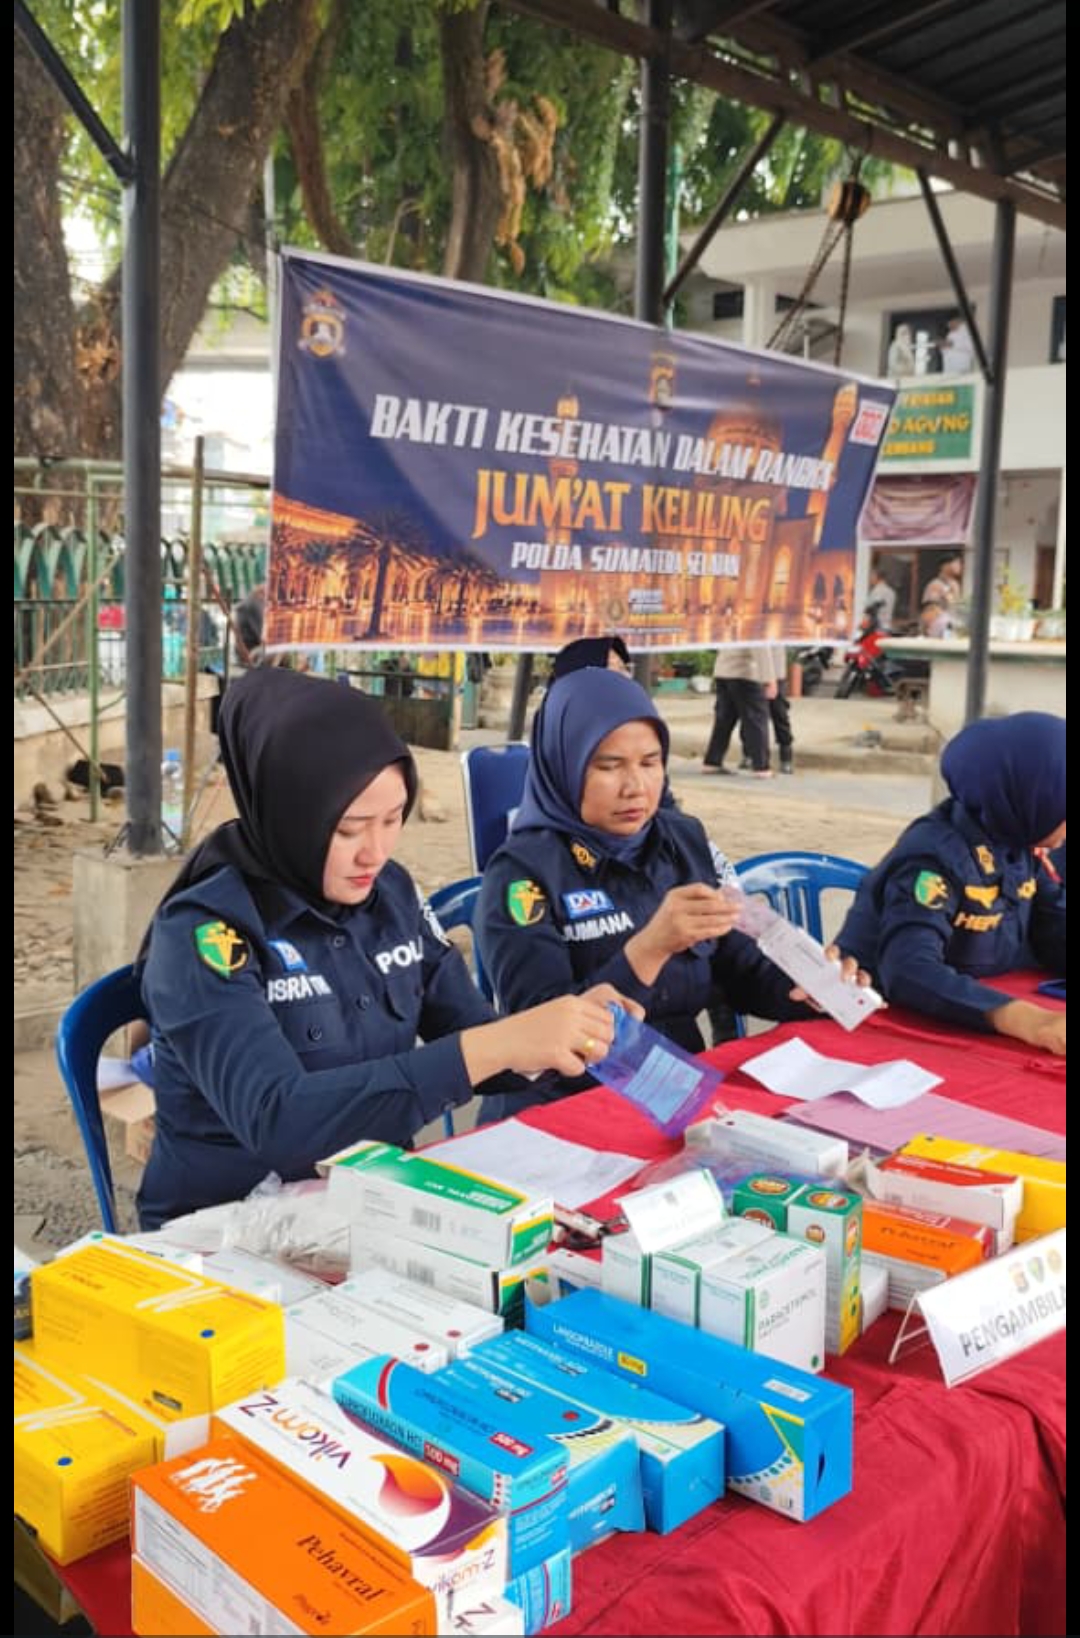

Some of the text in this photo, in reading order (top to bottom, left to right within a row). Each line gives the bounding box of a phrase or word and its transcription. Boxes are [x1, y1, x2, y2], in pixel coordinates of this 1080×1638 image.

[370, 394, 488, 449] BAKTI
[495, 412, 672, 469] KESEHATAN
[672, 435, 754, 480] DALAM
[640, 484, 772, 543] KELILING
[511, 541, 583, 571] POLDA
[296, 1534, 386, 1602] Pehavral
